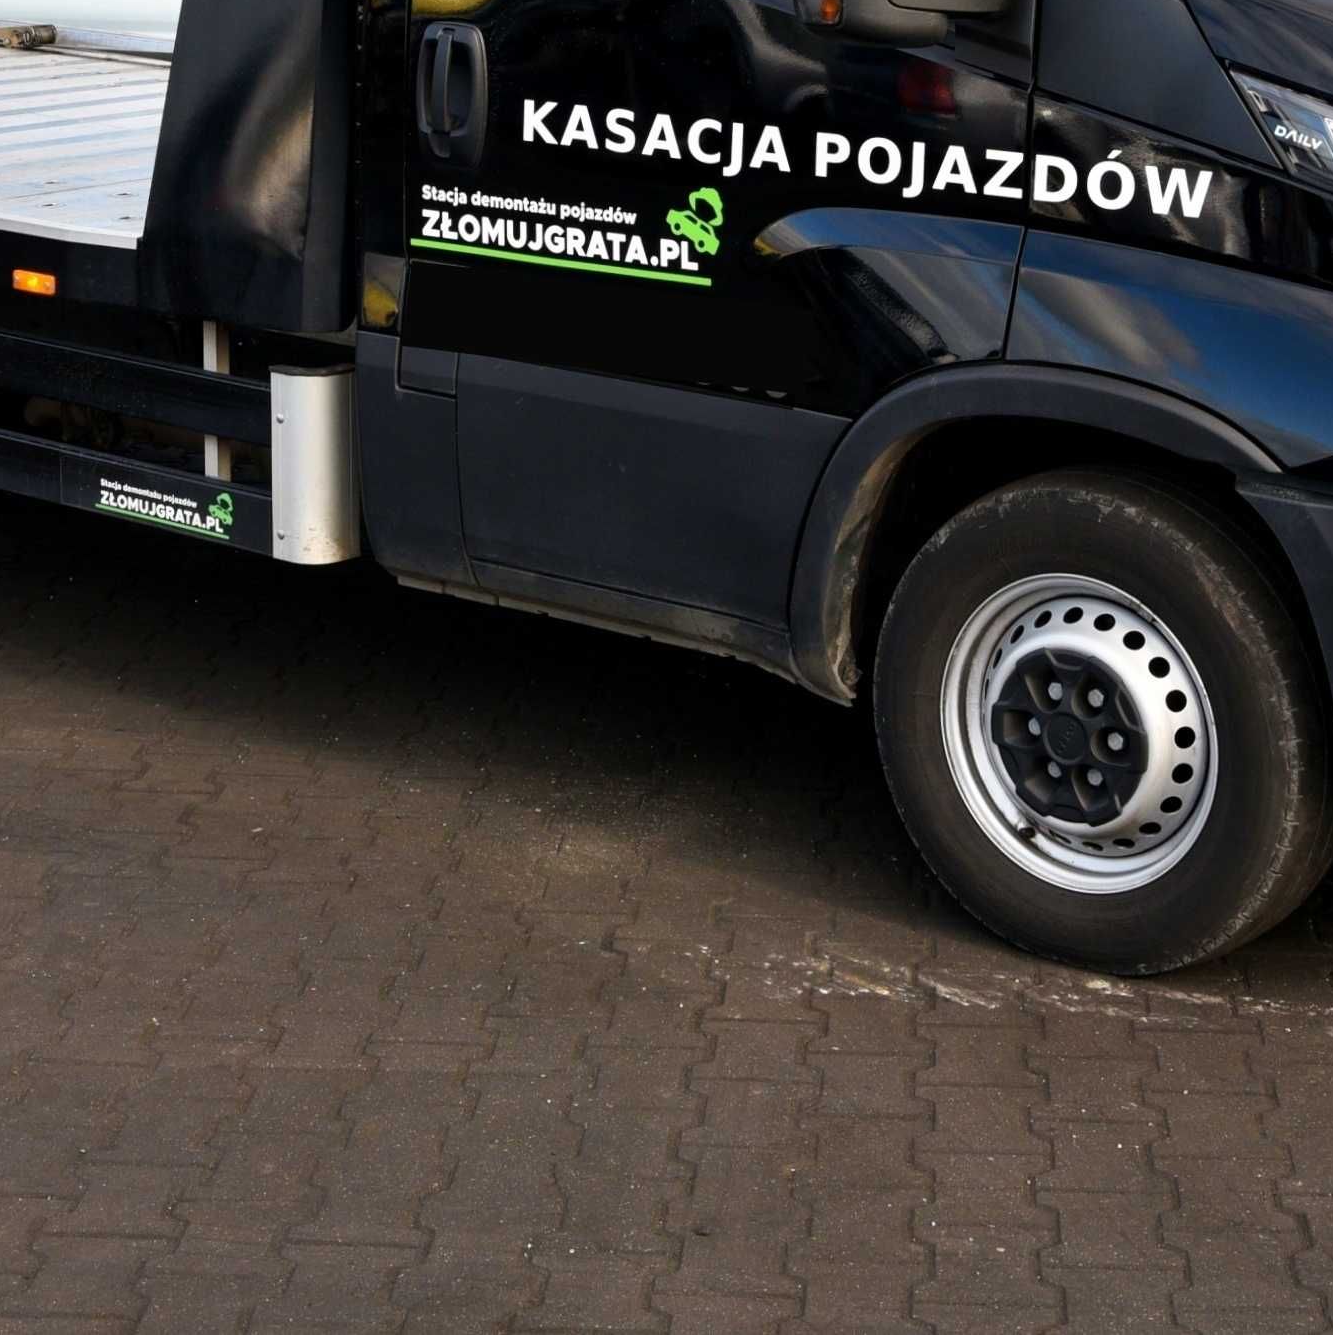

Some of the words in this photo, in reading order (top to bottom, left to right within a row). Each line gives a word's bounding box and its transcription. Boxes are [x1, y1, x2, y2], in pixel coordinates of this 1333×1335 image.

[1274, 124, 1323, 149] DAILY
[522, 99, 791, 177] KASACJA
[815, 132, 1213, 218] POJAZDÓW
[422, 184, 468, 206] Stacja
[471, 191, 556, 216] demontażu
[560, 202, 637, 225] pojazdów
[422, 209, 699, 271] ZŁOMUJGRATA.PL
[100, 478, 122, 491] Stacja
[163, 494, 197, 508] pojazdów
[100, 491, 224, 533] ZŁOMUJGRATA.PL
